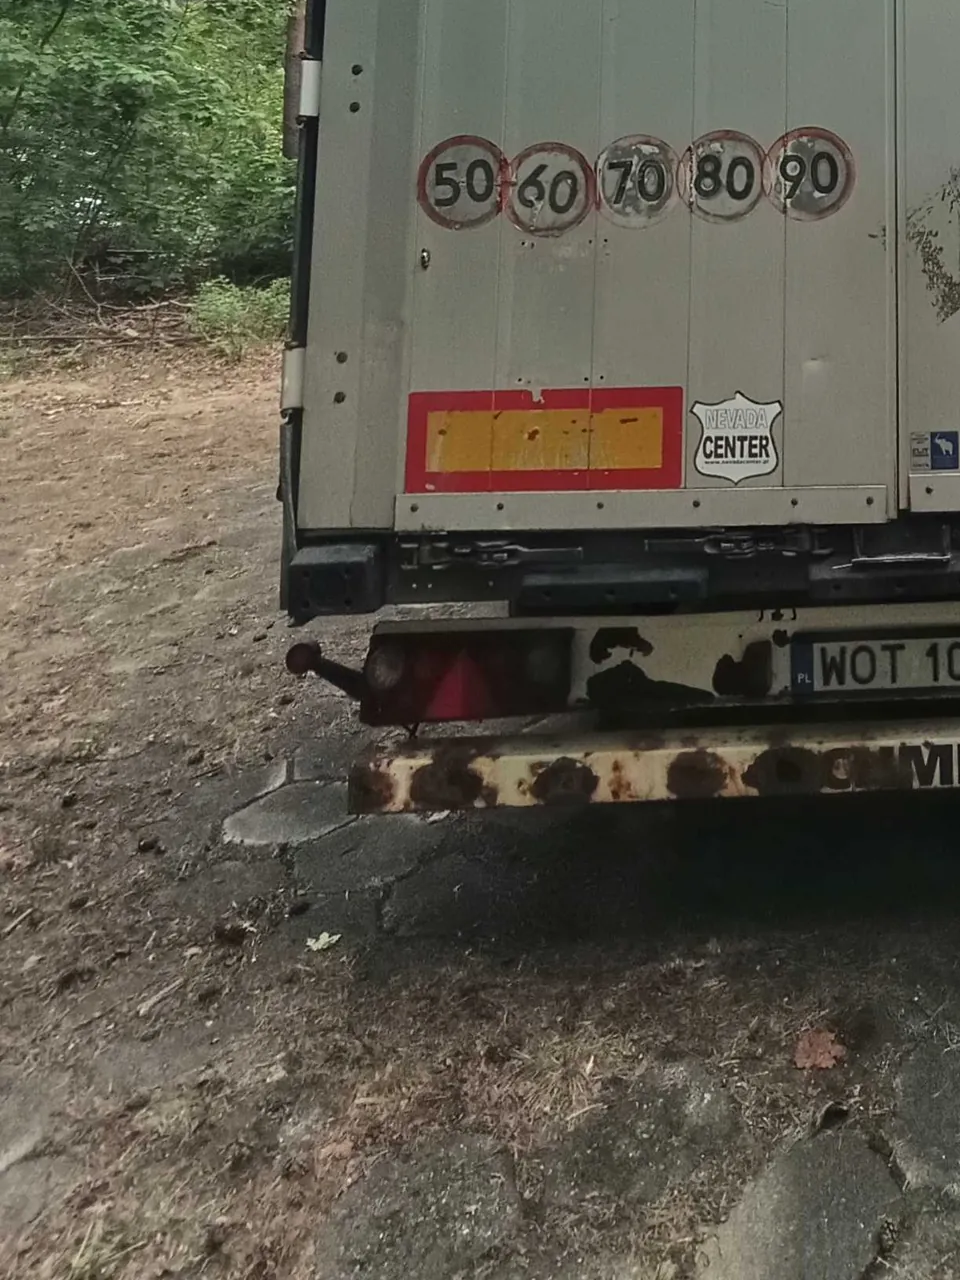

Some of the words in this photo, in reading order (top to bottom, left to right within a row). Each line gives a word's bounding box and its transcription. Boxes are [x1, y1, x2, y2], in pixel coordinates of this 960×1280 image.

[433, 158, 495, 208] 50
[516, 163, 579, 215] 60
[606, 158, 668, 206] 70
[694, 154, 754, 201] 80
[779, 150, 839, 200] 90
[704, 407, 769, 430] NEVADA
[702, 434, 771, 460] CENTER
[797, 673, 813, 684] PL
[820, 643, 906, 687] WOT
